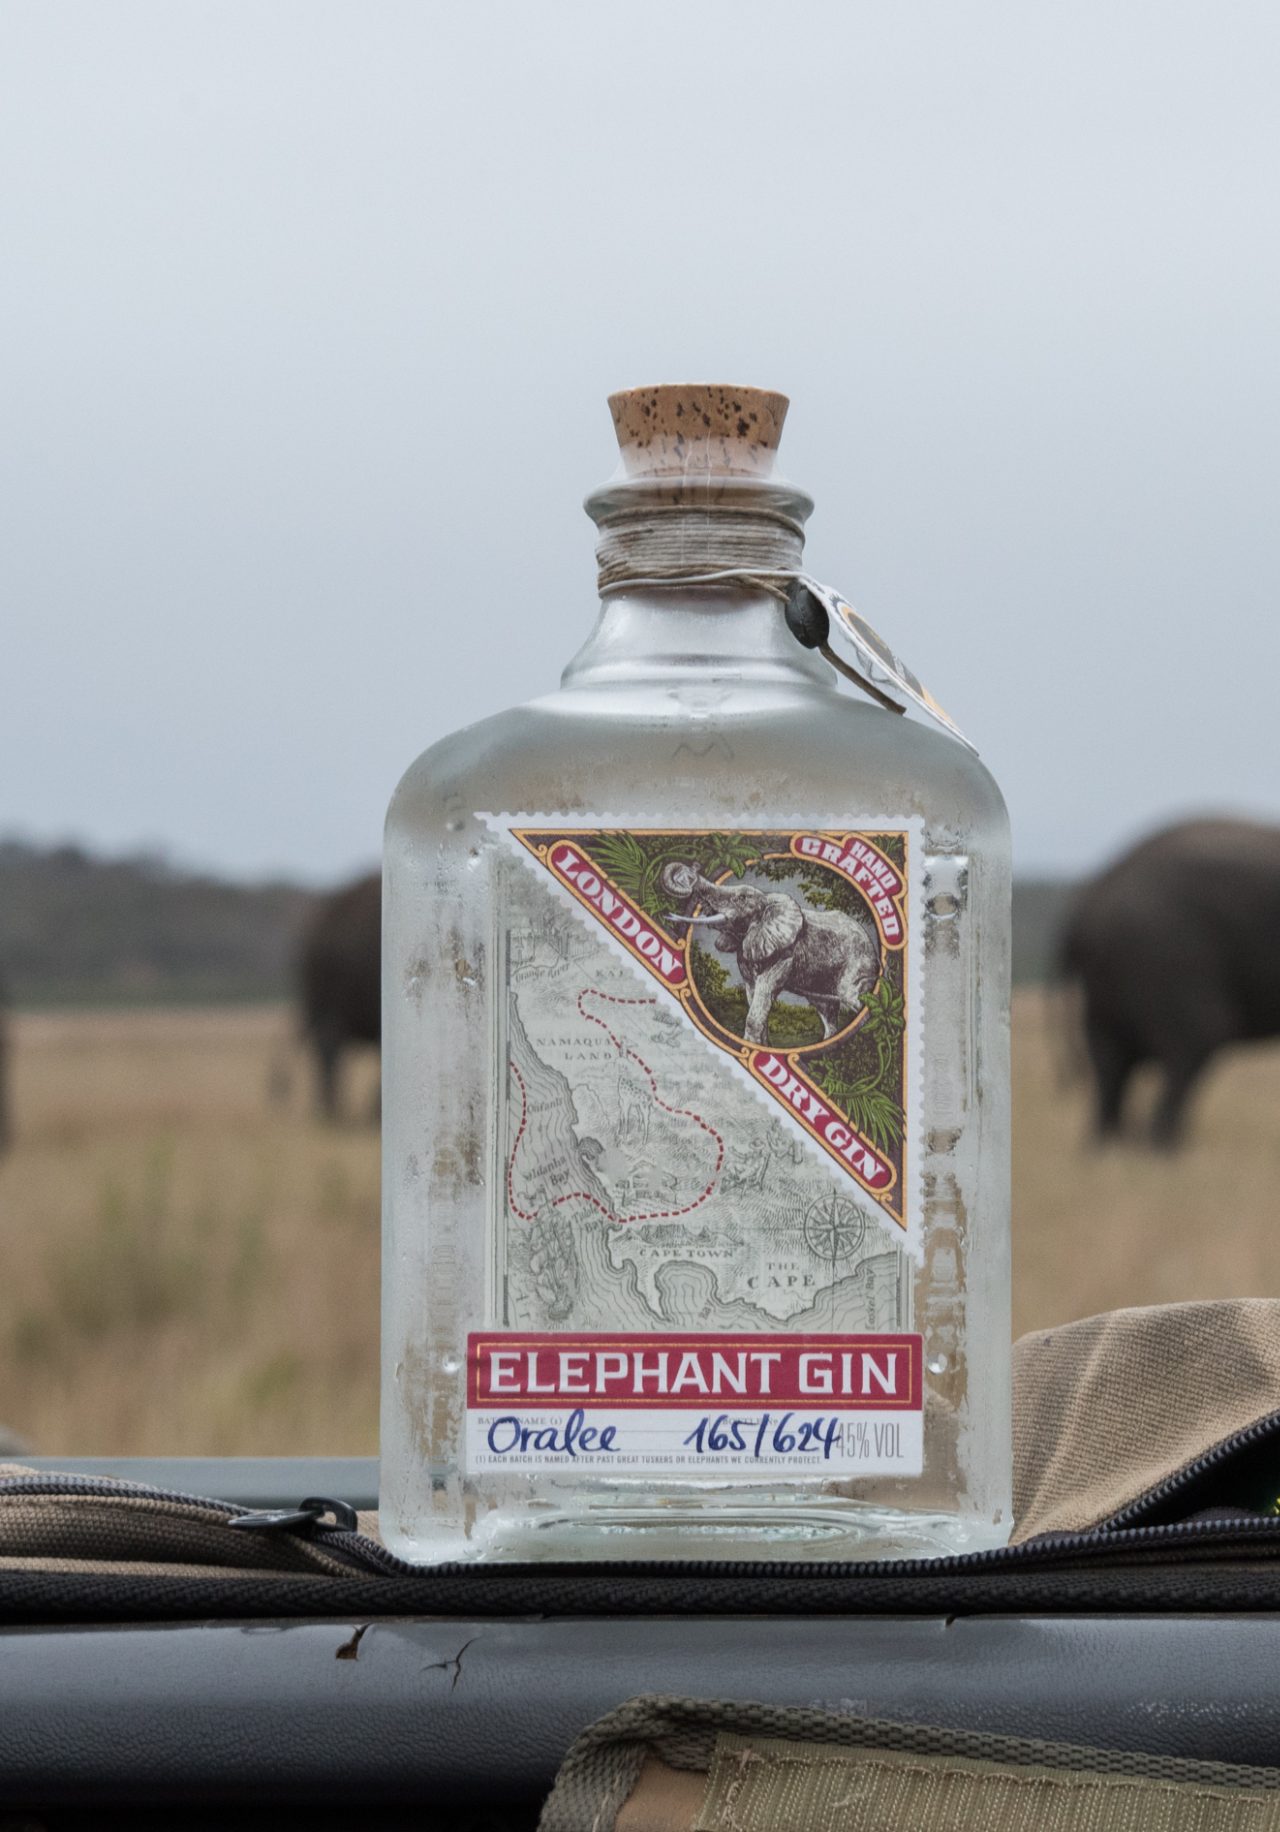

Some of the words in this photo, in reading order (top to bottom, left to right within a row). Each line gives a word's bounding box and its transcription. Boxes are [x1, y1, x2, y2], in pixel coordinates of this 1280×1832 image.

[849, 840, 897, 890] HAND
[801, 837, 900, 936] CRAFTED
[555, 850, 682, 976] LONDON
[564, 1053, 613, 1061] LAND
[758, 1054, 830, 1124] DRY
[825, 1121, 886, 1180] GIN
[640, 1250, 681, 1258] CAPE
[687, 1250, 733, 1258] TOWN
[768, 1262, 800, 1271] THE
[747, 1275, 816, 1290] CAPE
[488, 1351, 781, 1394] ELEPHANT
[799, 1352, 898, 1395] GIN
[487, 1408, 621, 1457] Oralee
[683, 1412, 841, 1460] 165/624
[874, 1421, 904, 1458] VOL
[488, 1455, 507, 1464] EACH
[510, 1455, 532, 1464] BATCH
[535, 1455, 542, 1464] IS
[545, 1455, 570, 1464] NAMED
[572, 1455, 594, 1464] AFTER
[597, 1455, 614, 1464] PAST
[617, 1455, 639, 1464] GREAT
[642, 1455, 673, 1464] TUSKERS
[676, 1455, 685, 1464] OR
[688, 1455, 729, 1464] ELEPHANTS
[731, 1455, 742, 1464] WE
